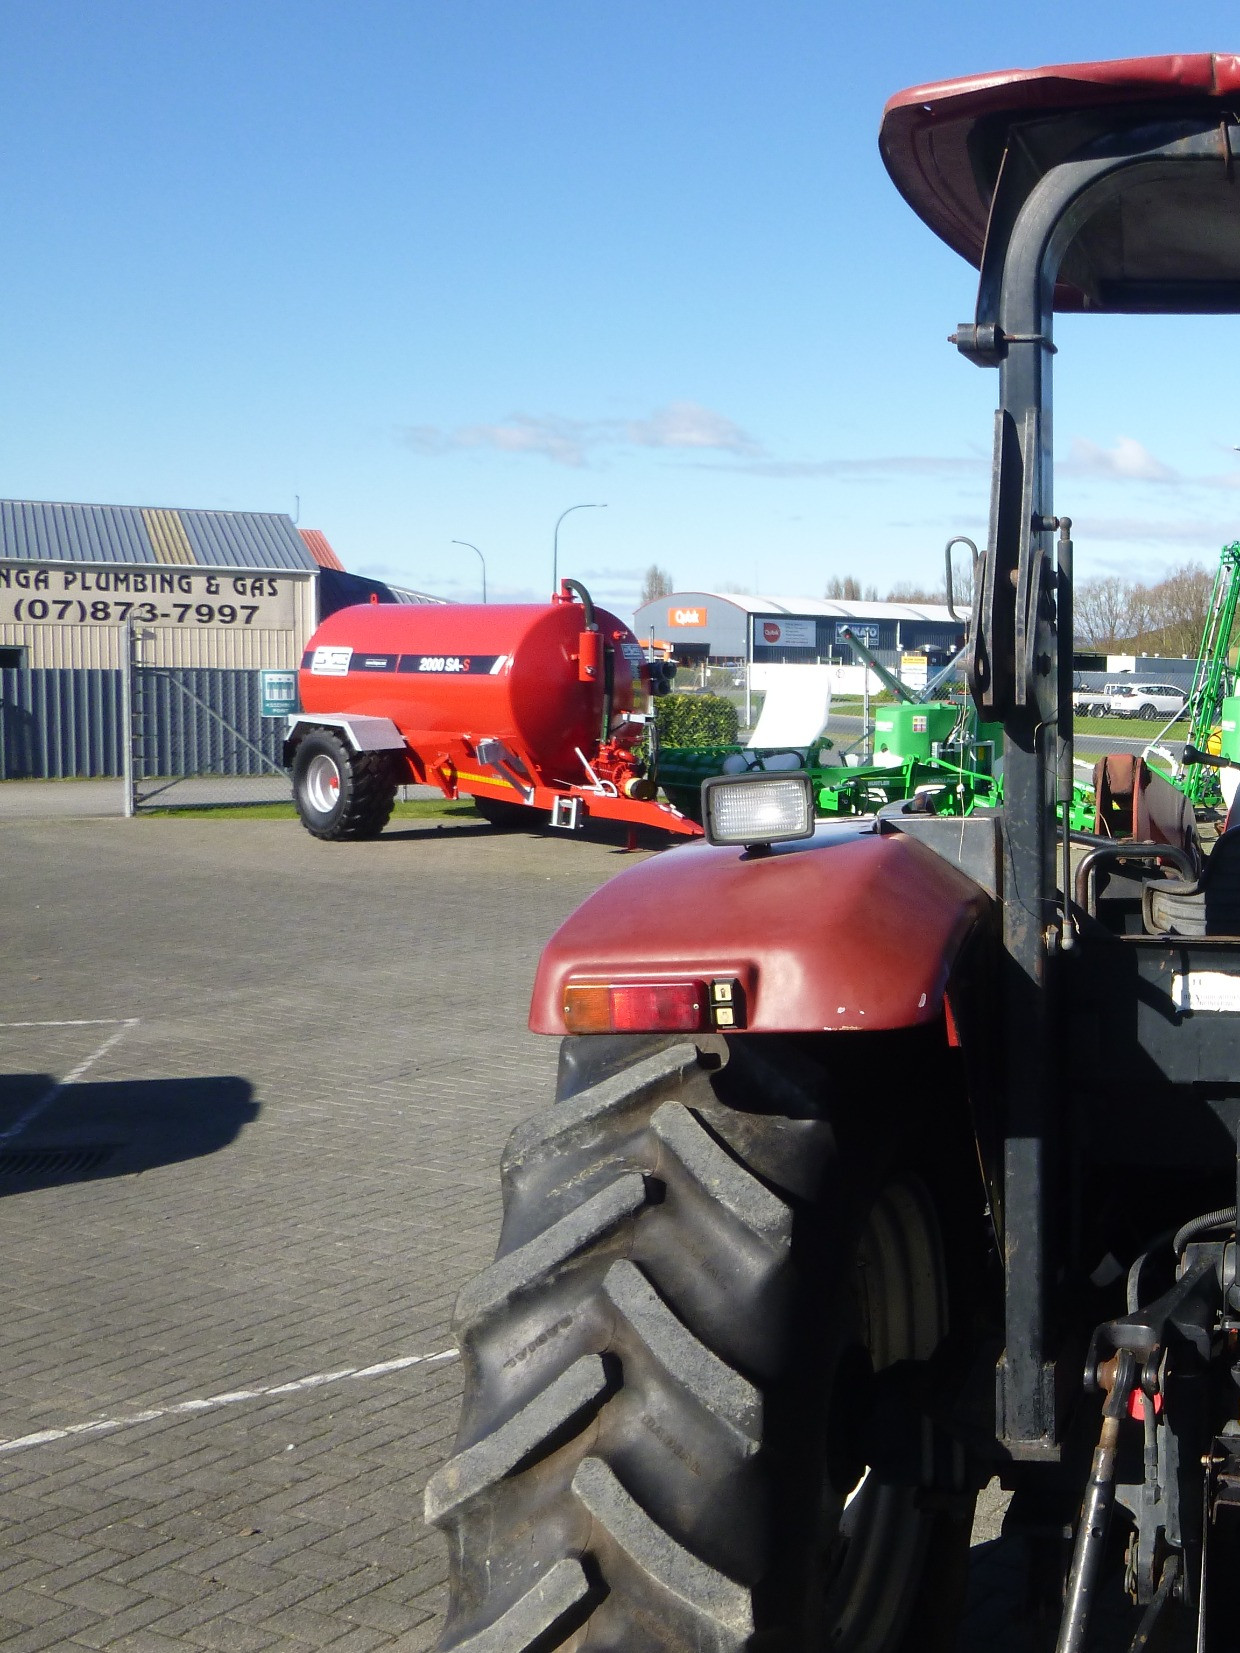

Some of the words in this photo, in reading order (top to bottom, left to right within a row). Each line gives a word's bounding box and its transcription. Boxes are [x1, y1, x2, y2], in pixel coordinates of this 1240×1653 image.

[64, 571, 192, 595] PLUMBING
[206, 575, 220, 596] &
[233, 576, 278, 598] GAS
[14, 599, 260, 625] (07)873-7997
[418, 657, 445, 672] 2000
